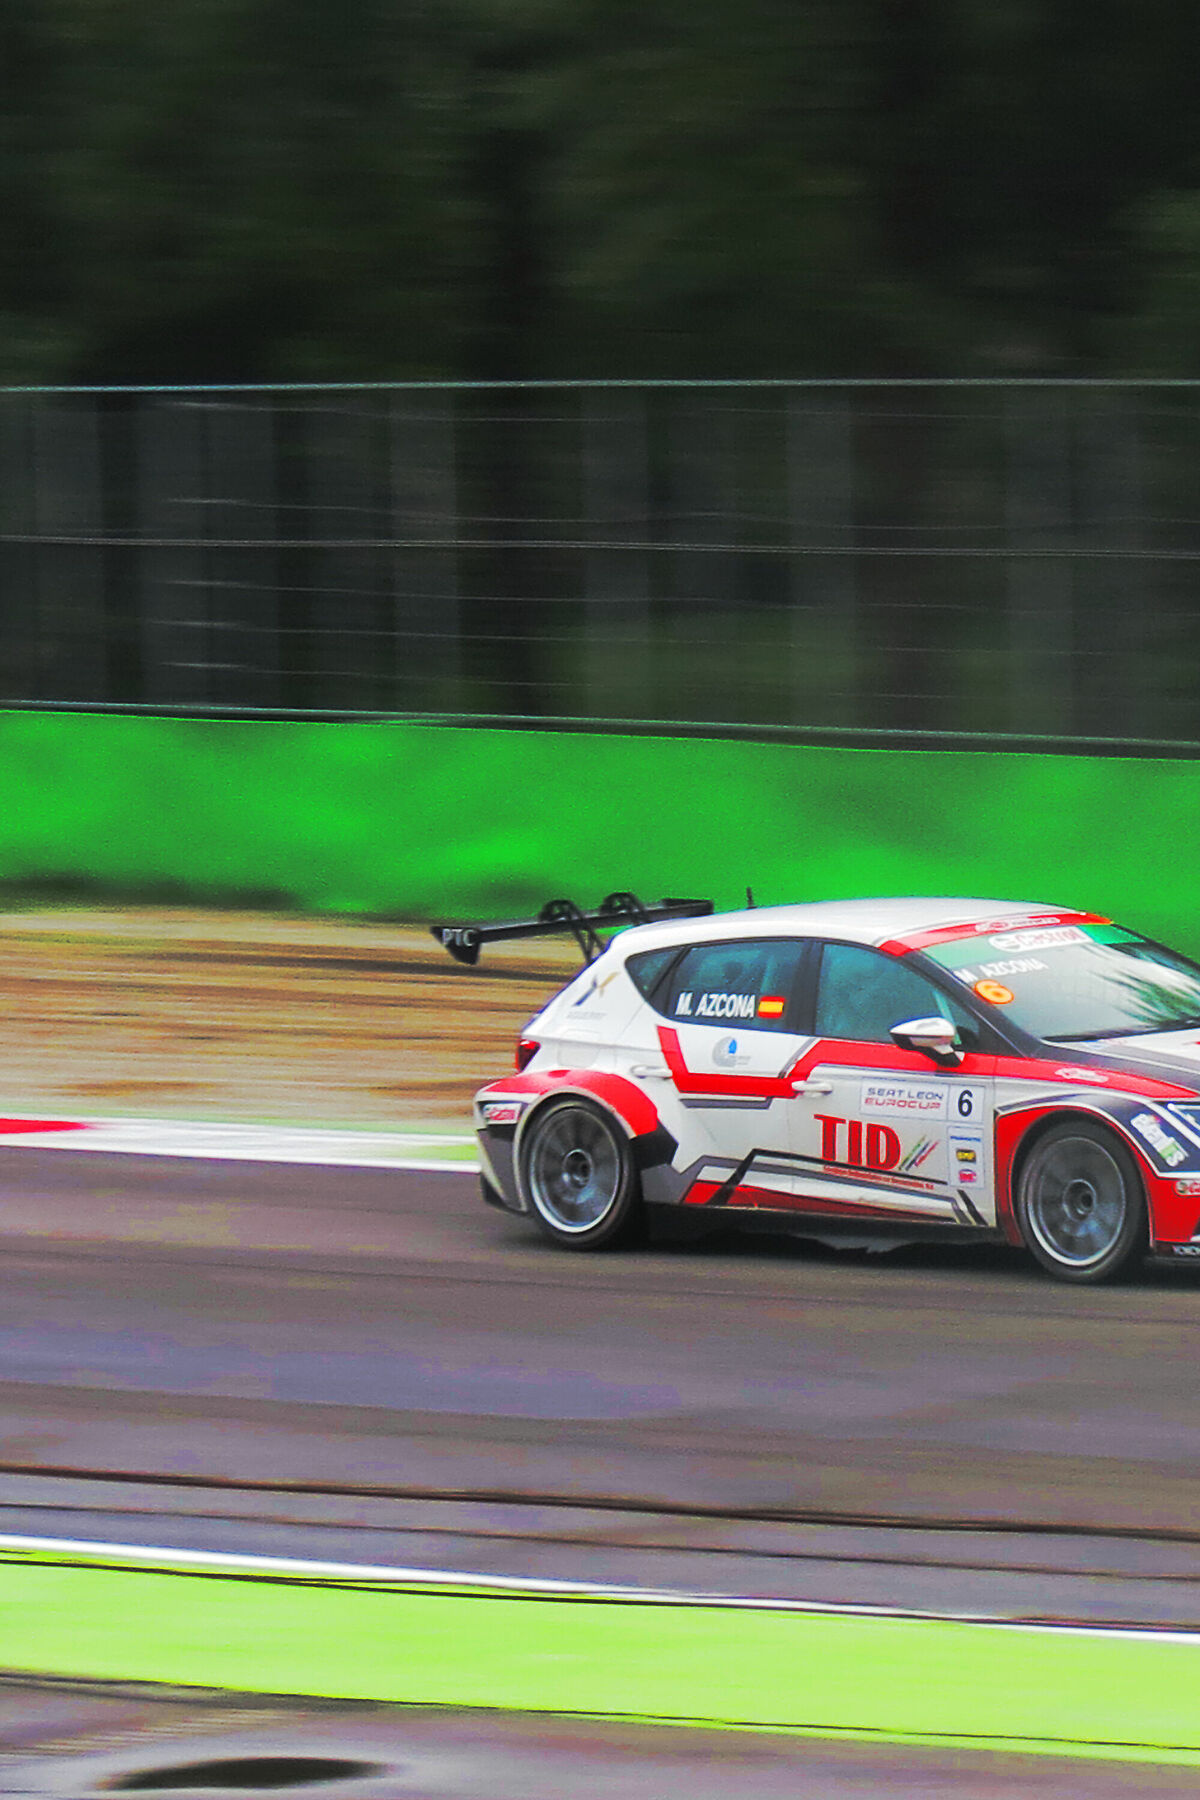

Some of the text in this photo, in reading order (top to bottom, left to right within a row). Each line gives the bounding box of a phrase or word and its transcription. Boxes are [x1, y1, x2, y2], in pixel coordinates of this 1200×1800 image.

[442, 928, 475, 947] PTC
[979, 958, 1048, 977] AZCONA
[973, 978, 1015, 1005] 6
[675, 992, 756, 1018] M. AZCONA
[864, 1097, 942, 1110] EUROCUP
[867, 1087, 944, 1101] SEAT LEON
[957, 1089, 973, 1117] 6
[813, 1114, 901, 1171] TID
